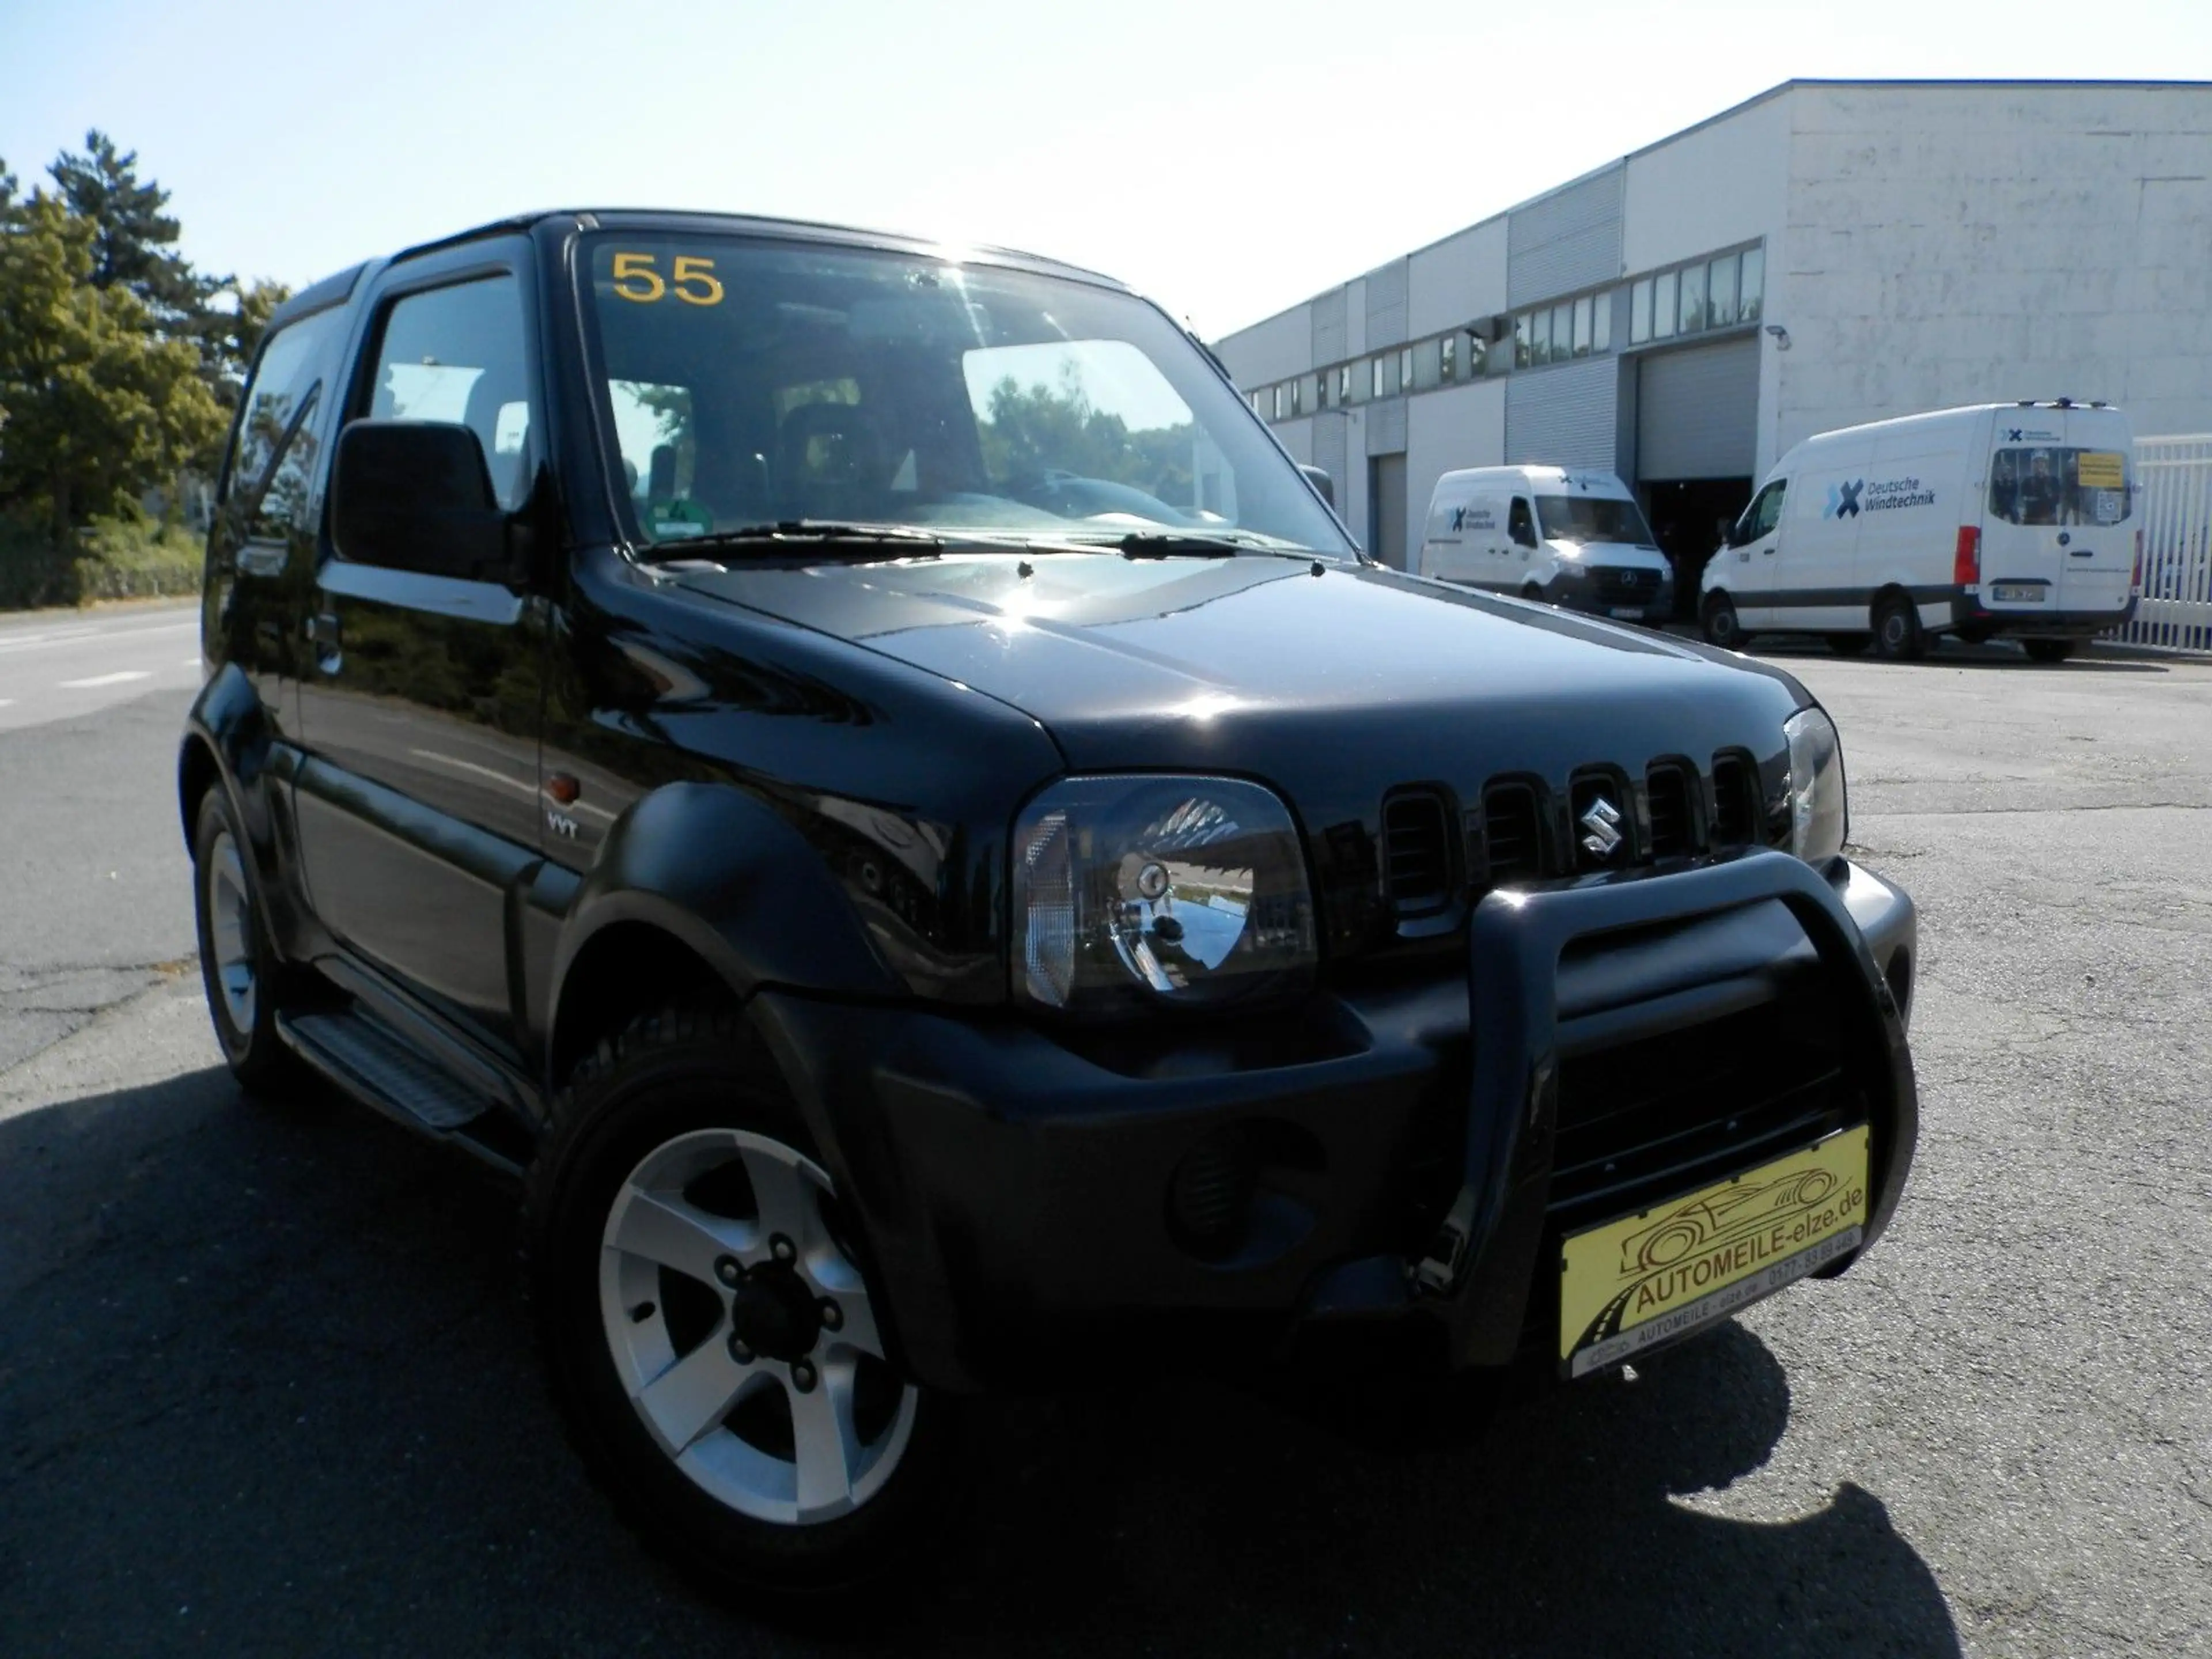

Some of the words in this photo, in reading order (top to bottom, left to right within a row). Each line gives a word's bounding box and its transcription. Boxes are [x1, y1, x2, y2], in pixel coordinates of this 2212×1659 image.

[613, 252, 725, 306] 55
[1865, 489, 1936, 512] Windtechnik
[1869, 476, 1919, 495] Deutsche
[1636, 1187, 1863, 1314] AUTOMEILE-elze.de
